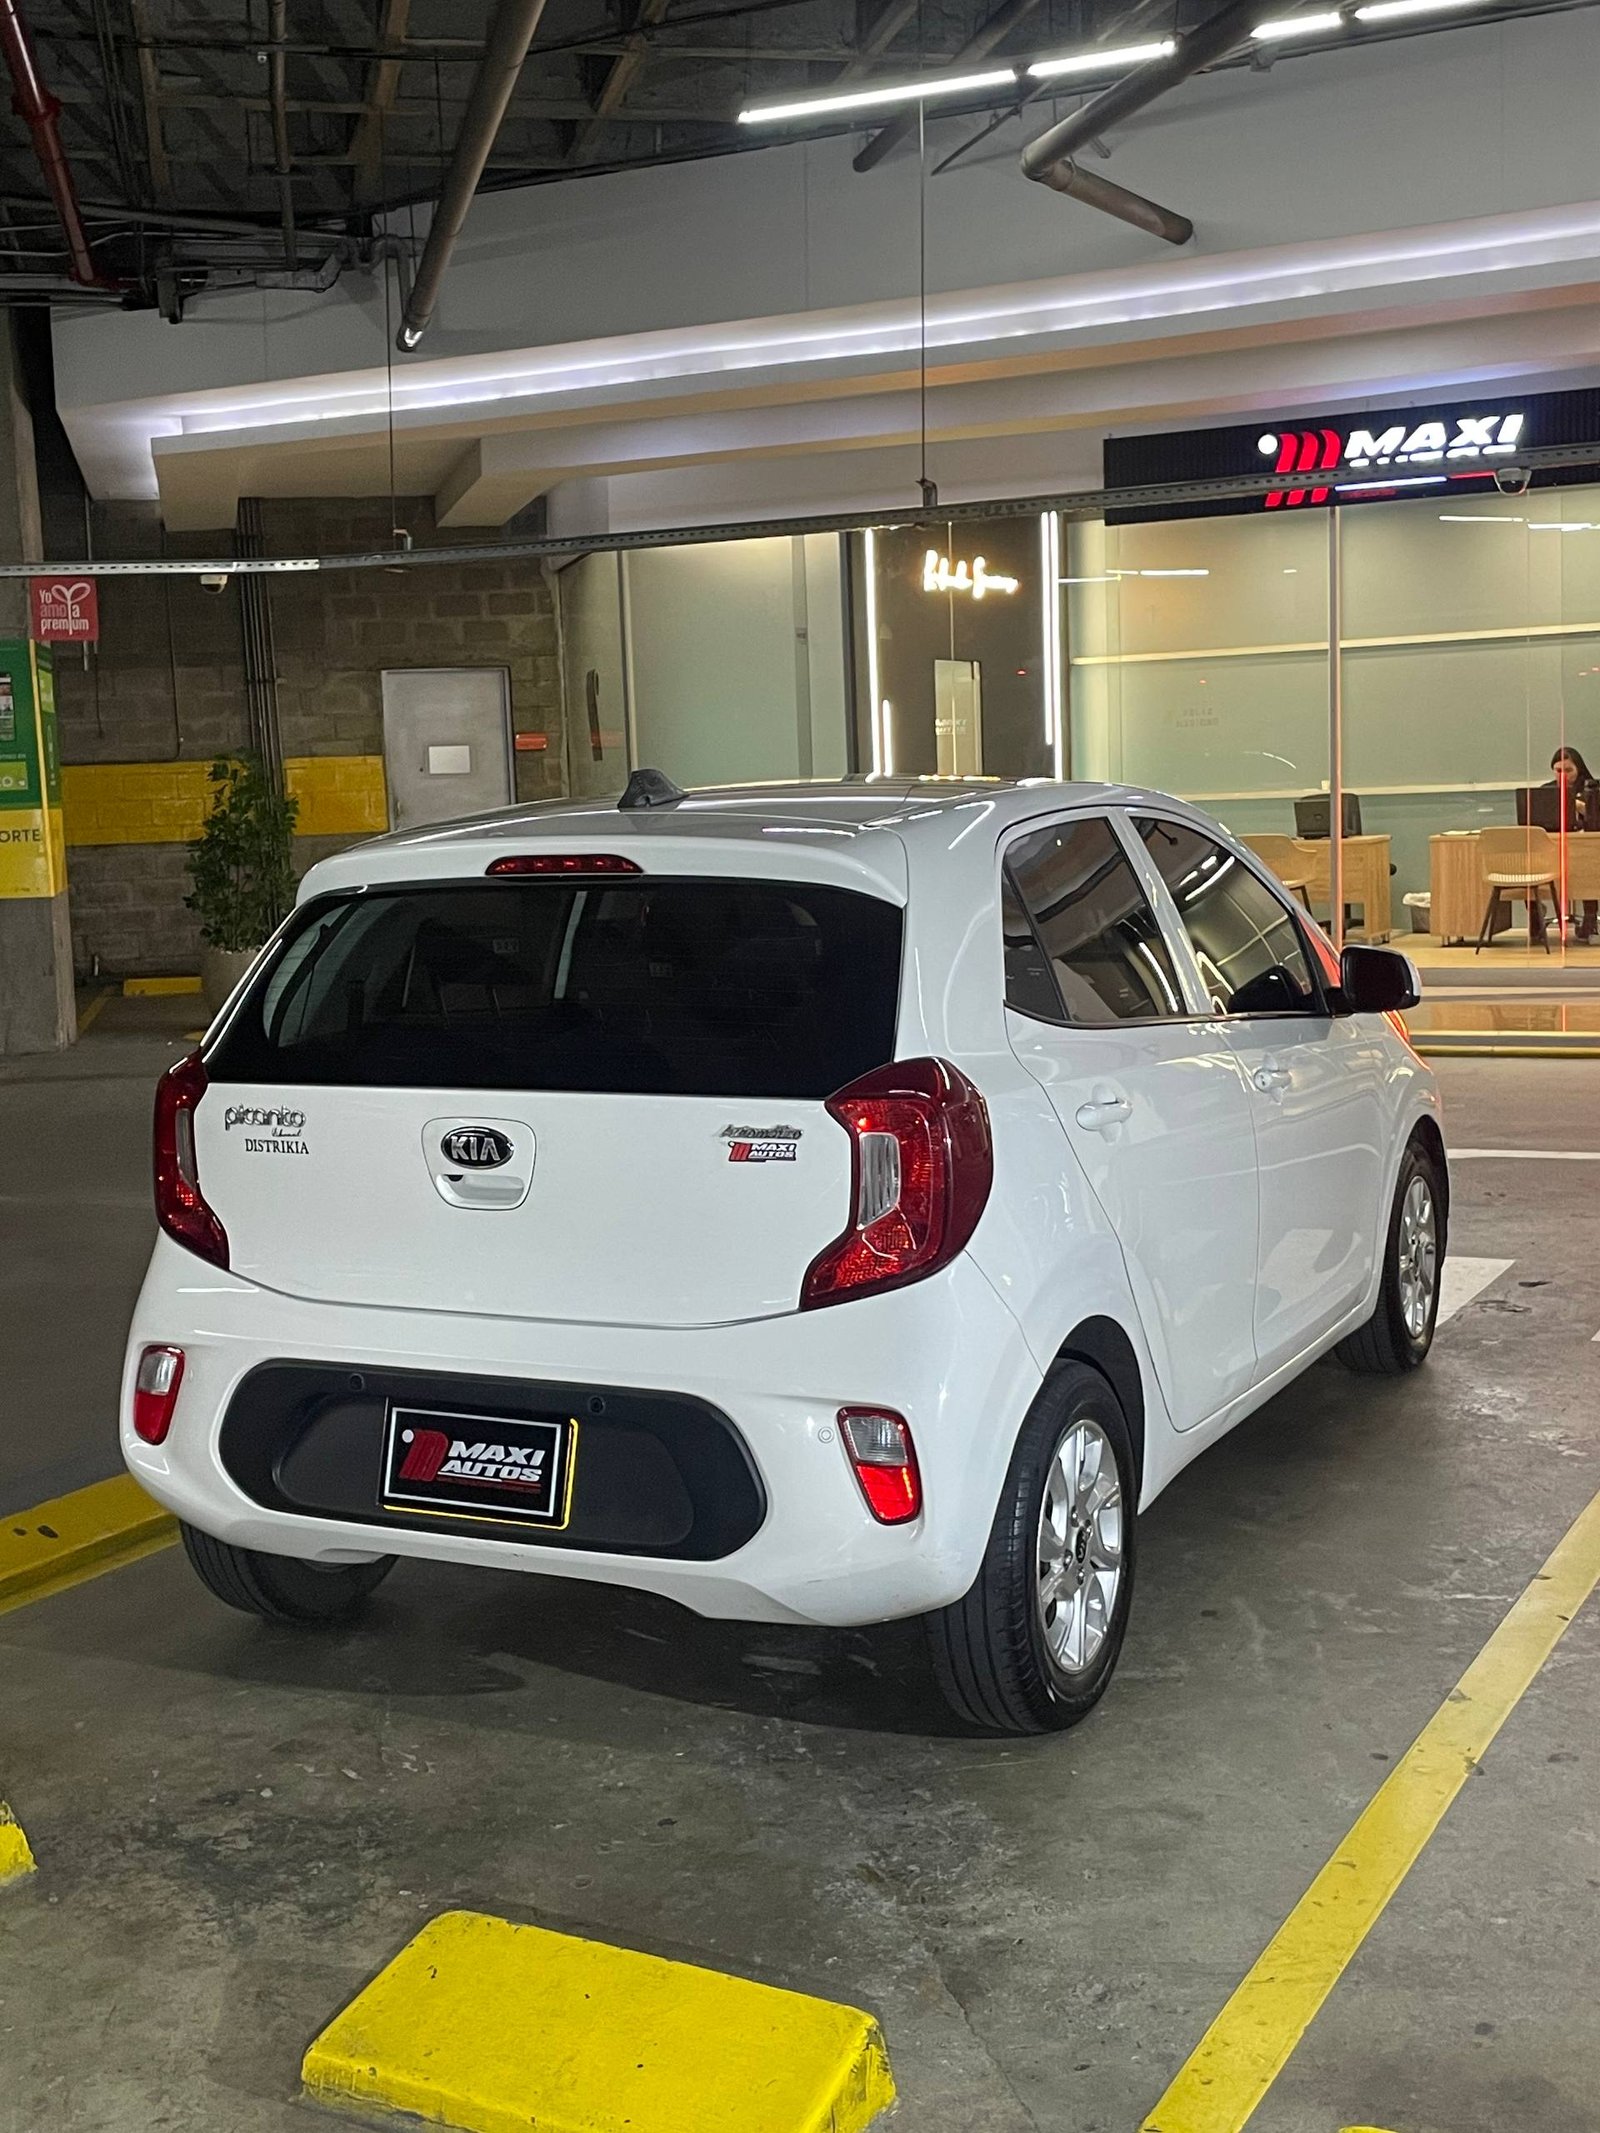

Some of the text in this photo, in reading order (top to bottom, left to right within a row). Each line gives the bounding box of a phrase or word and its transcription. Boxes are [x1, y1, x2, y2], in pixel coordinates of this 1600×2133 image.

[1344, 414, 1524, 459] MAXI
[39, 589, 52, 604] Yo
[40, 604, 67, 618] amo
[225, 1103, 307, 1131] picanto
[244, 1138, 310, 1155] DISTRIKIA
[450, 1135, 501, 1161] KIA
[447, 1440, 546, 1467] MAXI
[440, 1460, 543, 1482] AUTOS
